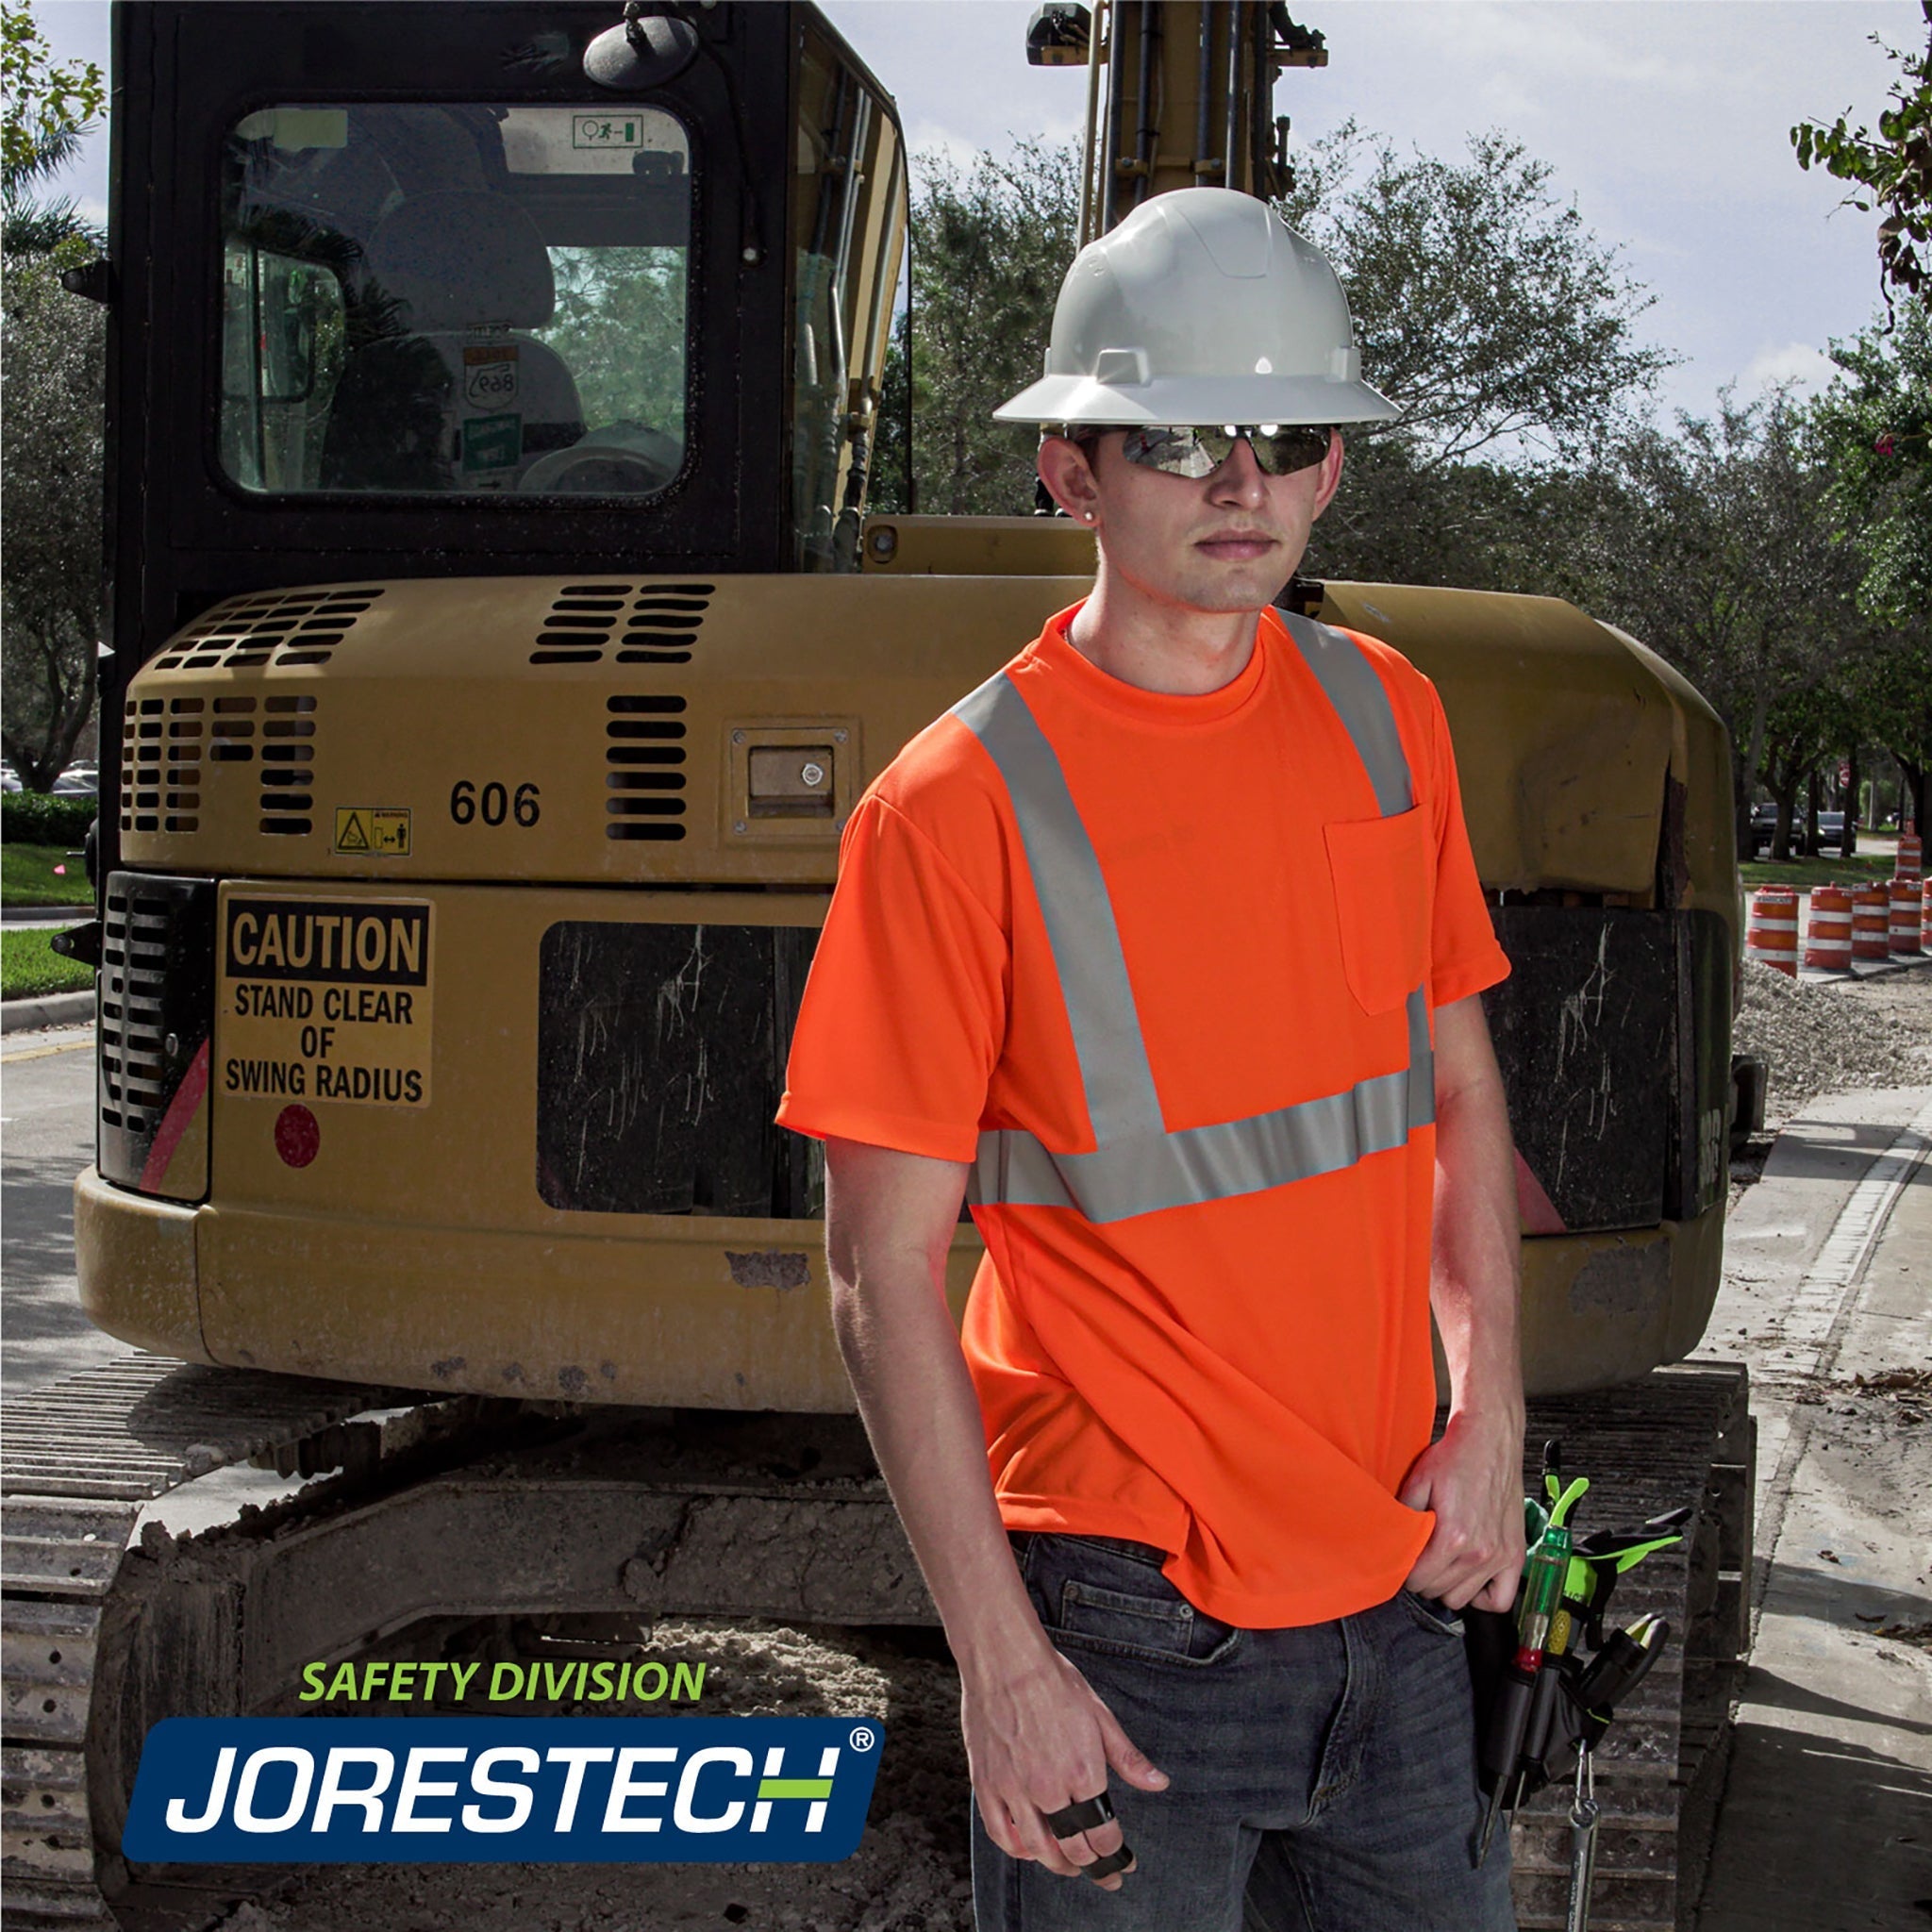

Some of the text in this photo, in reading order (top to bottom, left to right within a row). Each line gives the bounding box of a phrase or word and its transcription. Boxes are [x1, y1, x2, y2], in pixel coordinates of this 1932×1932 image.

[450, 780, 541, 827] 606
[232, 912, 422, 973] CAUTION
[235, 984, 413, 1024] STAND CLEAR
[301, 1025, 335, 1058] OF
[225, 1058, 423, 1102] SWING RADIUS
